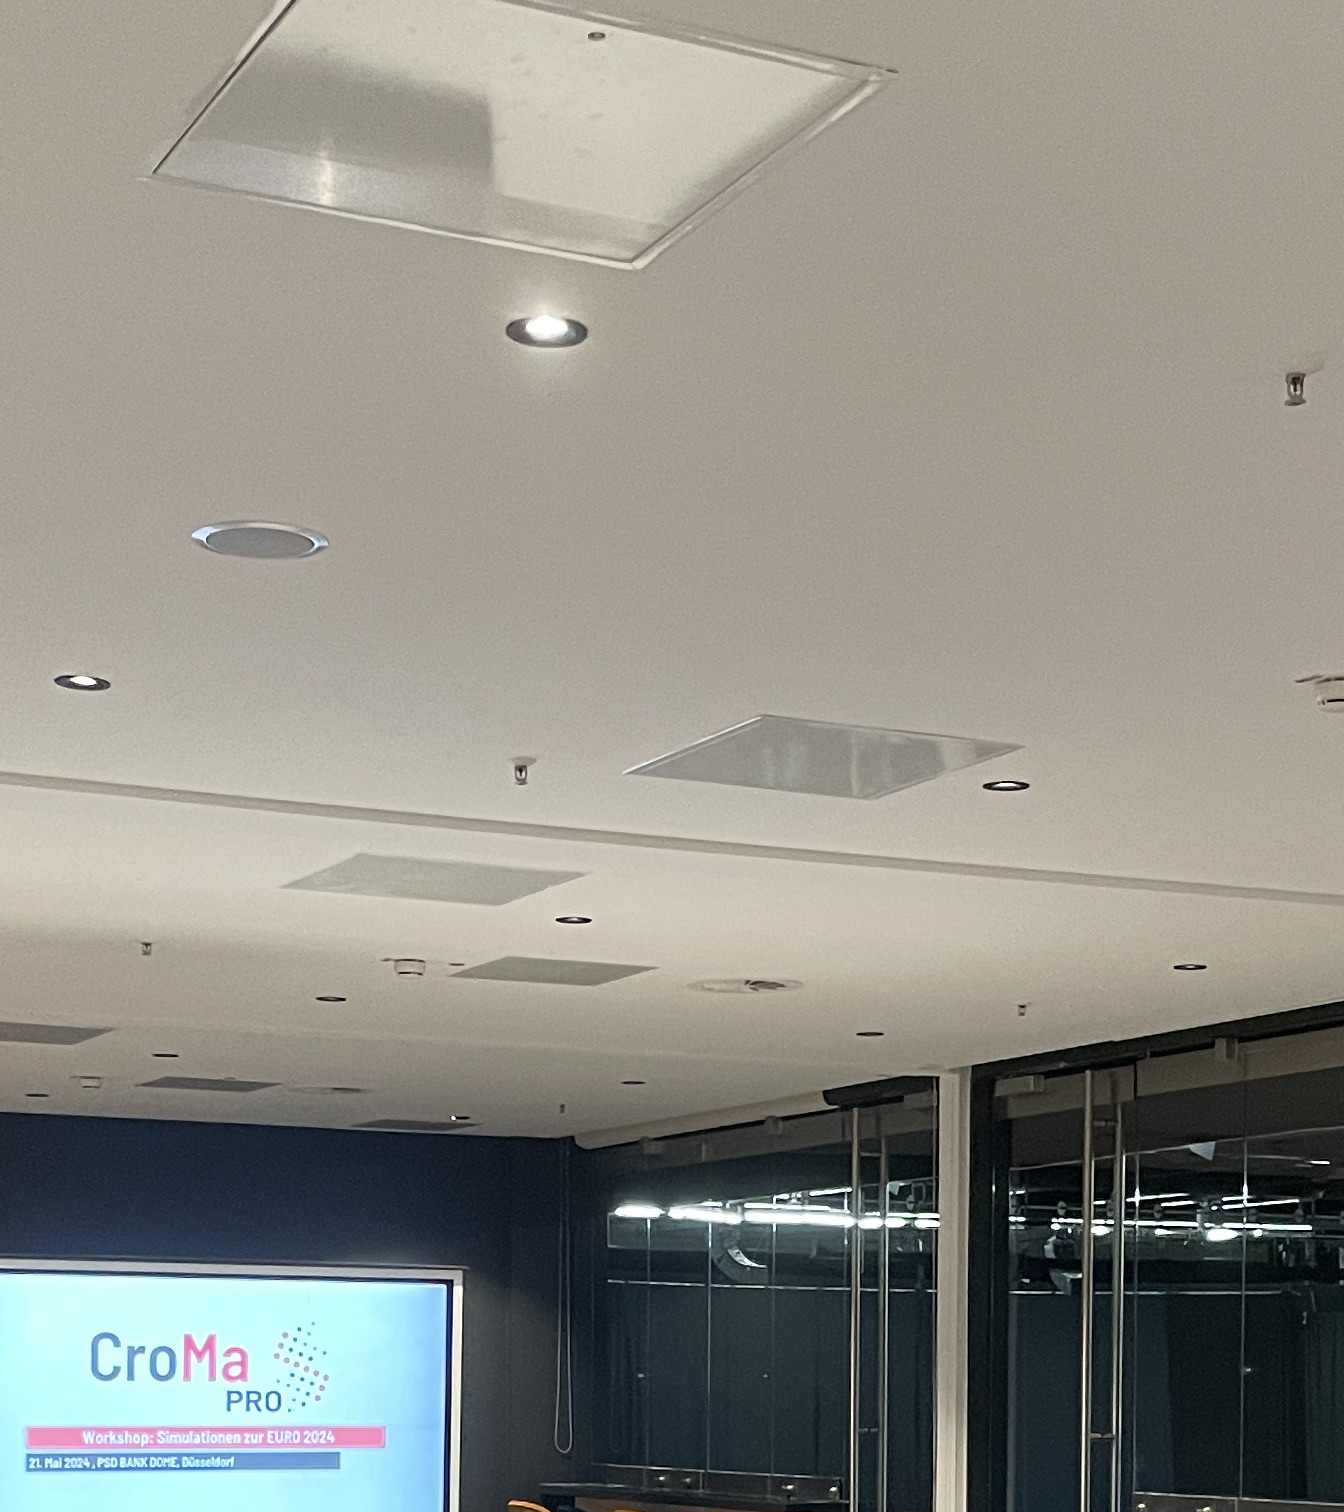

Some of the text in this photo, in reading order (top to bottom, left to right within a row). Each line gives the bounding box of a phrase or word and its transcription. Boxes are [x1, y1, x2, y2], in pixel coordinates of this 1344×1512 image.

[91, 1332, 249, 1382] CroMa
[226, 1390, 283, 1412] PRO
[81, 1430, 336, 1447] Workshop: Simulationen zur EURO 2024
[44, 1457, 63, 1469] Mai
[182, 1456, 235, 1468] Düsseldorf
